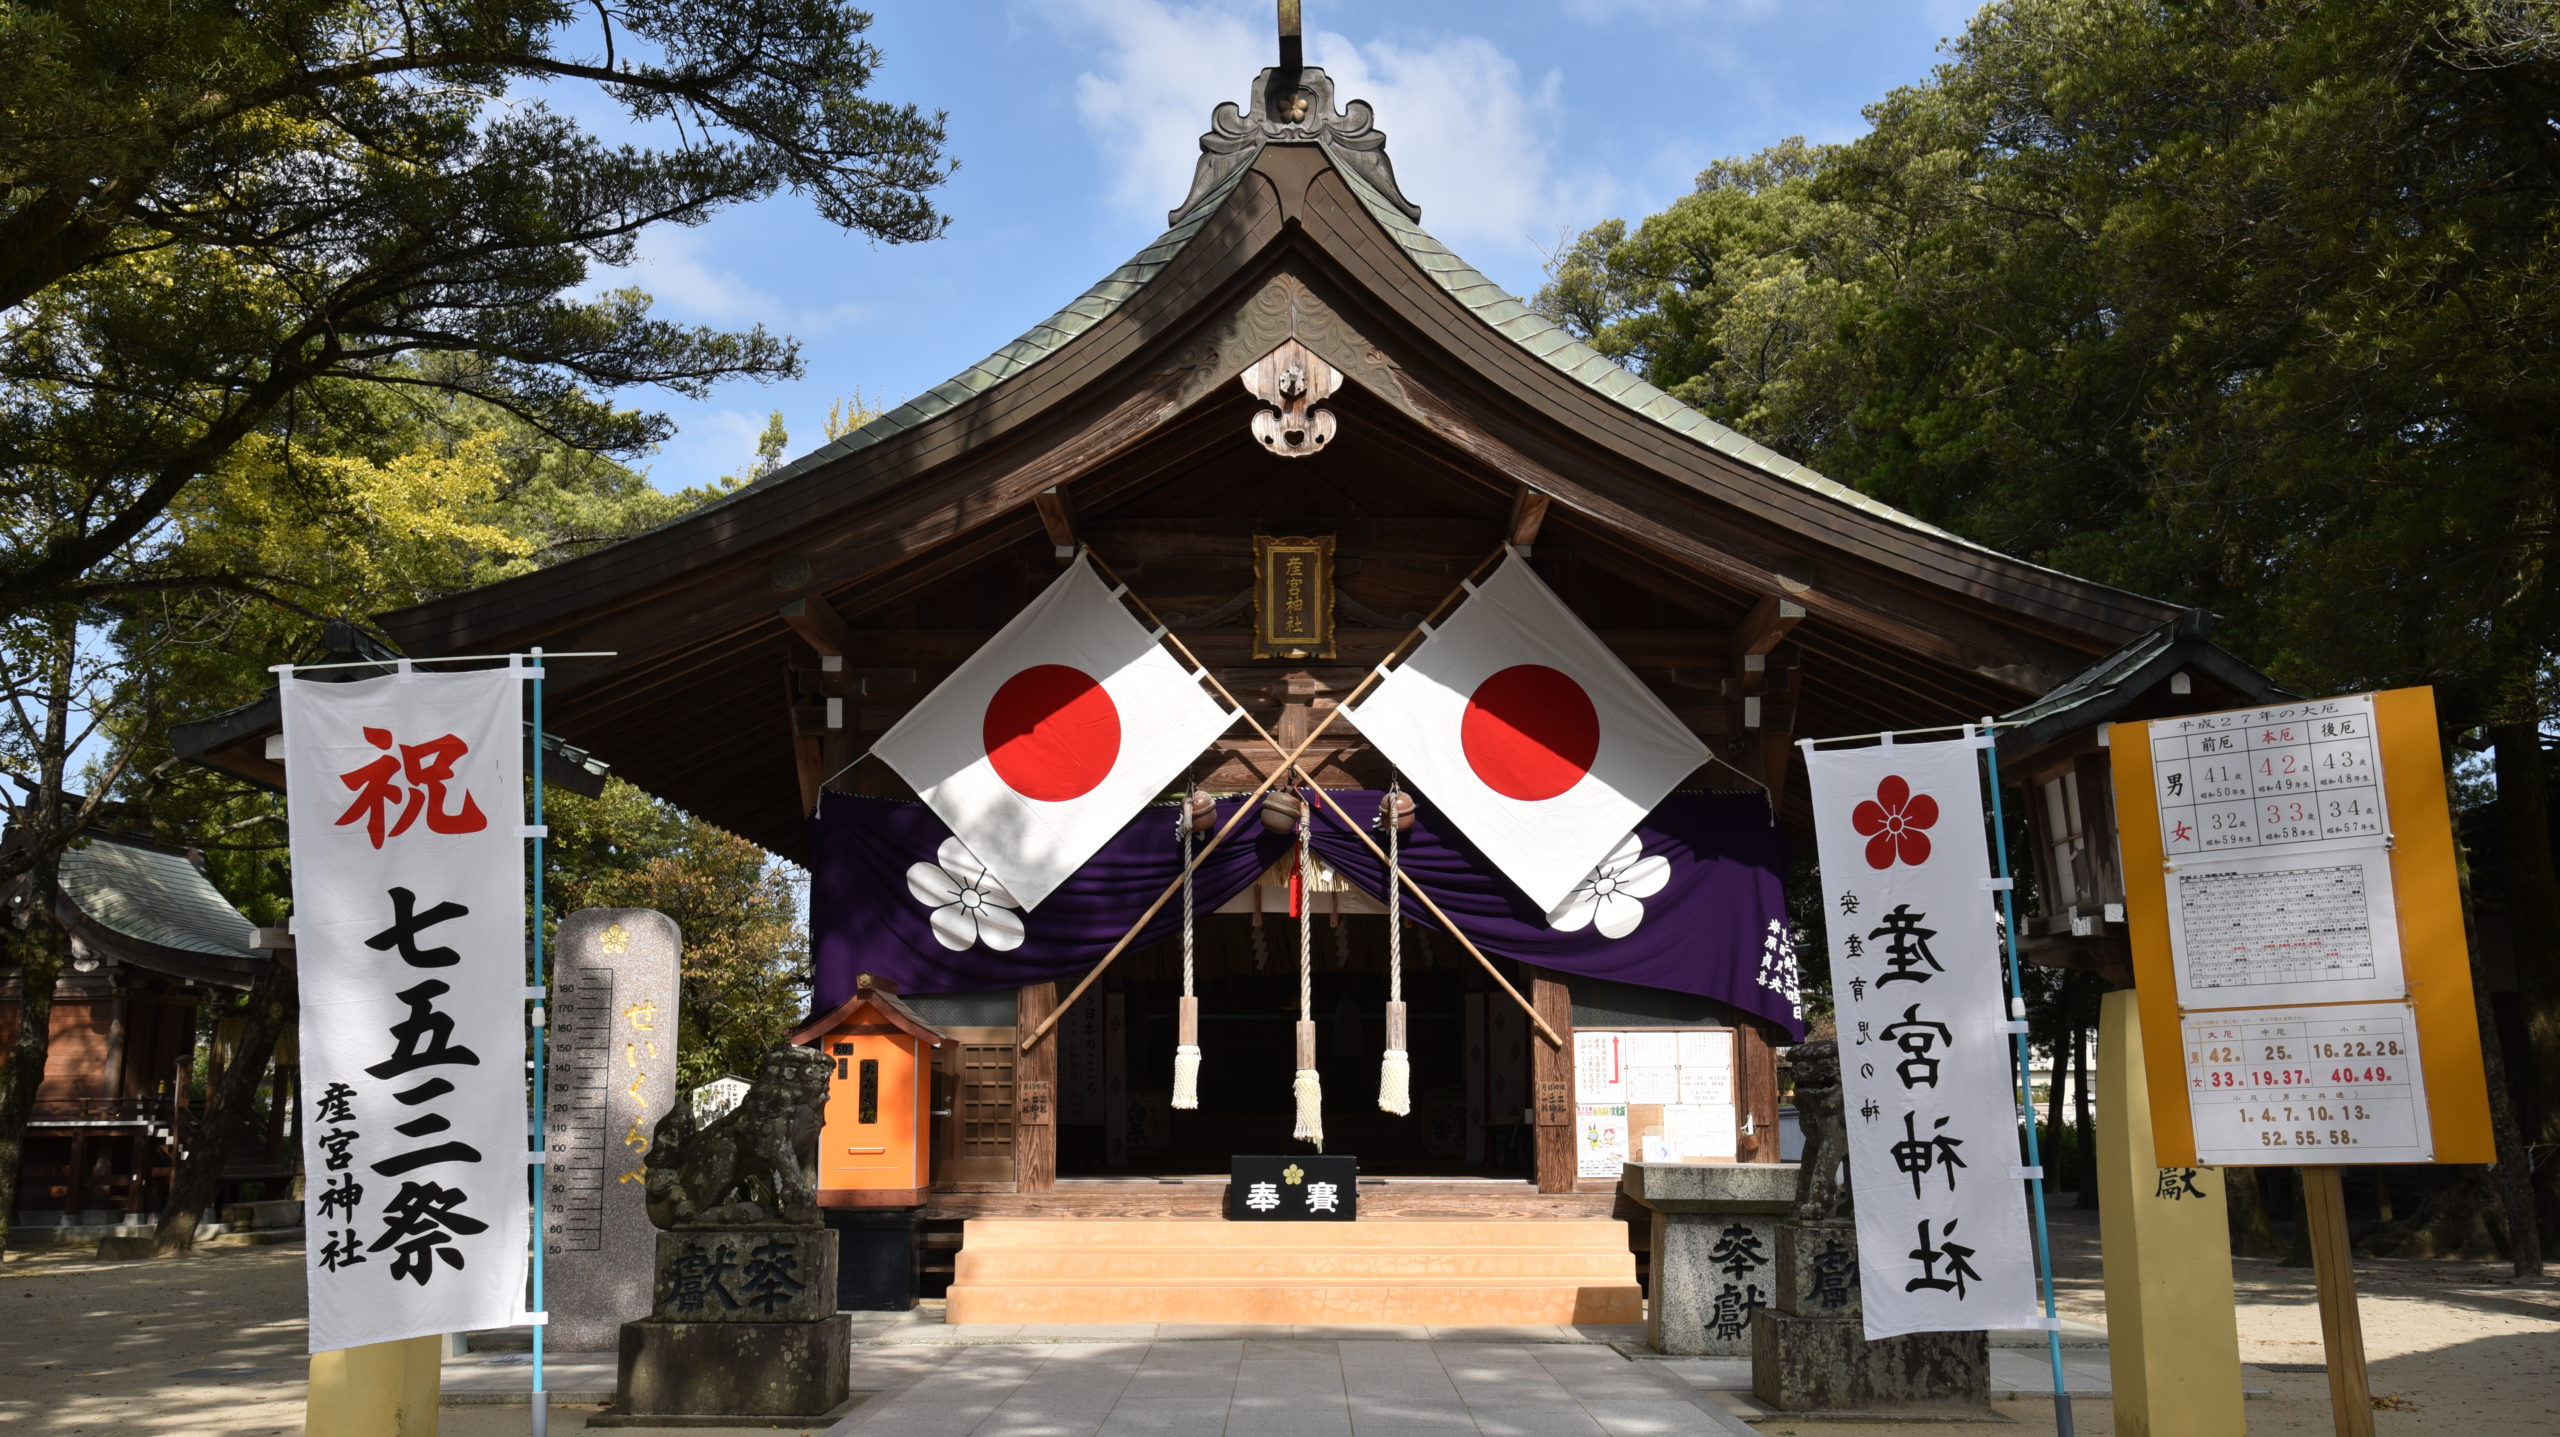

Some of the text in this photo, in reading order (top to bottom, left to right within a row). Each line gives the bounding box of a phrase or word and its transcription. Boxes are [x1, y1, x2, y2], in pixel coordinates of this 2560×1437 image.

[1285, 556, 1304, 633] 産宮神社
[2201, 720, 2355, 752] 前厄 本厄 後厄
[2167, 773, 2183, 796] 男
[336, 728, 487, 850] 祝
[2170, 821, 2192, 842] 女
[559, 985, 574, 993] 180
[558, 1004, 573, 1013] 170
[557, 1024, 572, 1032] 160
[556, 1044, 572, 1052] 150
[556, 1064, 571, 1072] 140
[2192, 1076, 2202, 1087] 女
[364, 887, 490, 1286] 七五三祭
[554, 1084, 570, 1092] 130
[553, 1104, 568, 1112] 120
[552, 1124, 567, 1132] 110
[551, 1144, 566, 1152] 100
[554, 1164, 565, 1172] 90
[316, 1083, 368, 1273] 産宮神社
[552, 1184, 564, 1192] 80
[551, 1205, 563, 1213] 70
[550, 1225, 562, 1234] 60
[550, 1246, 561, 1254] 50
